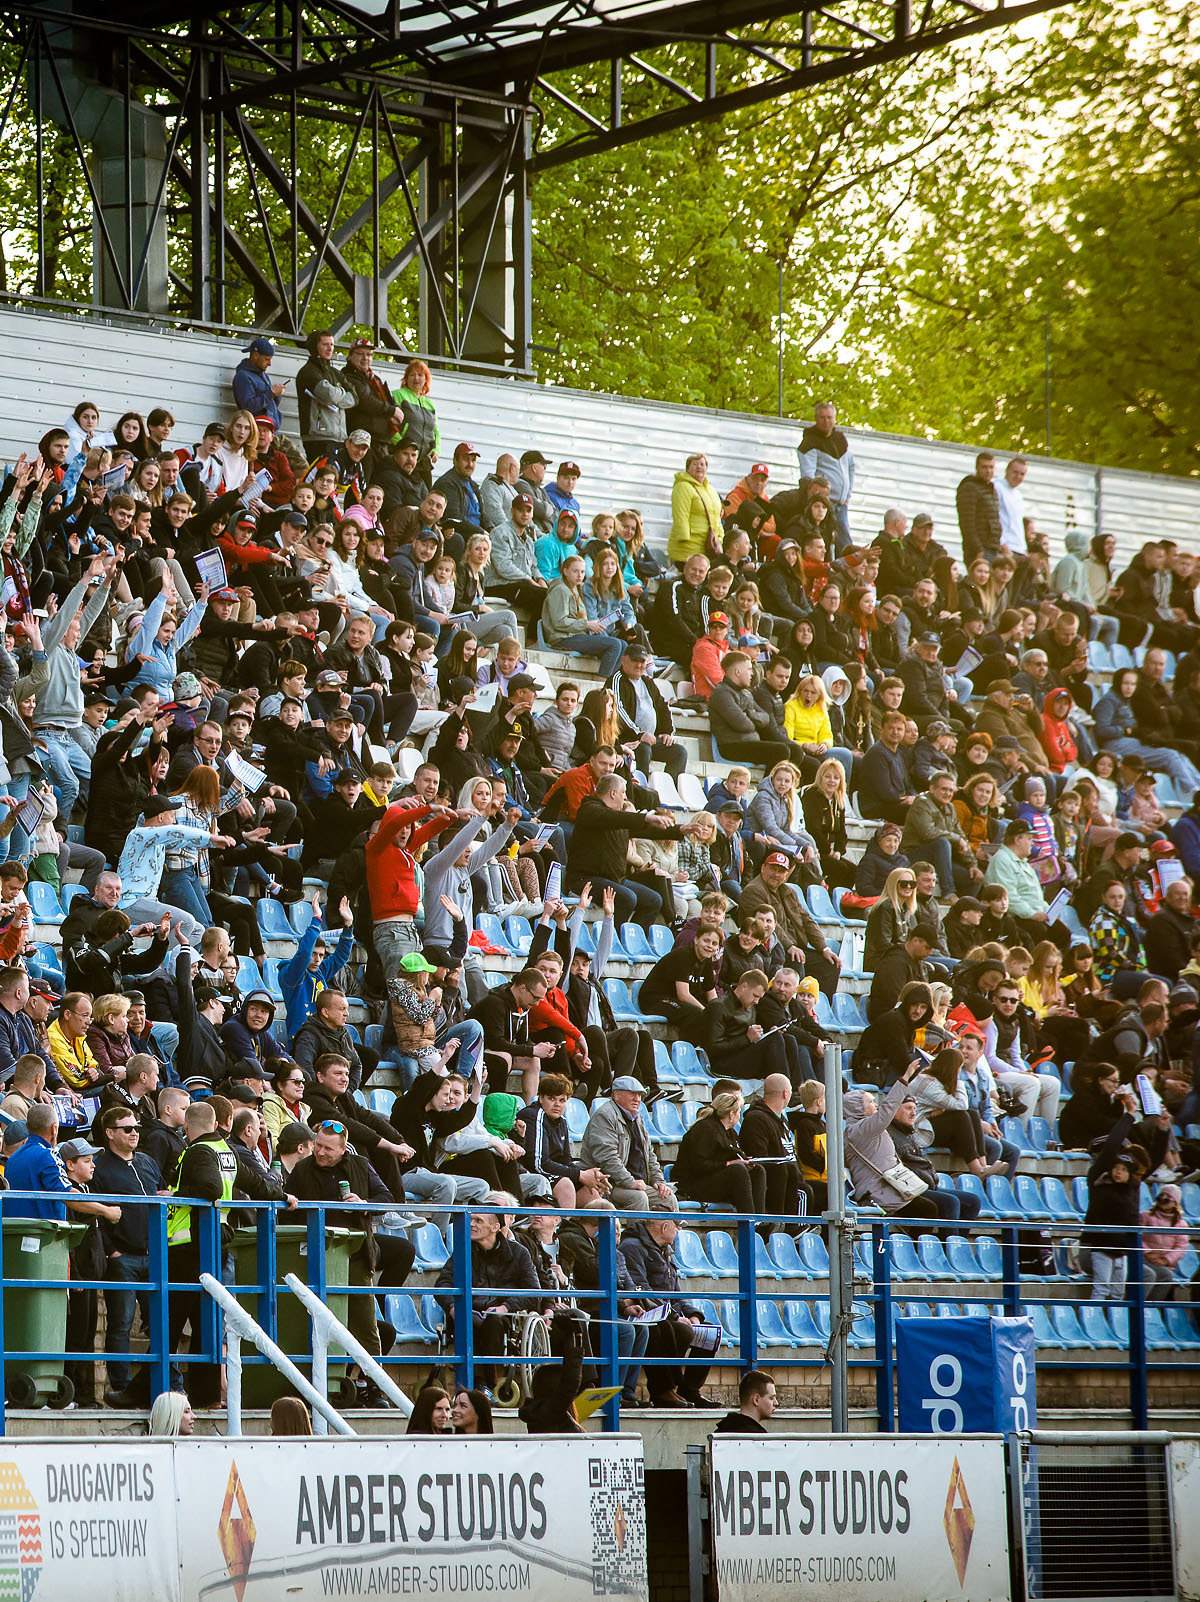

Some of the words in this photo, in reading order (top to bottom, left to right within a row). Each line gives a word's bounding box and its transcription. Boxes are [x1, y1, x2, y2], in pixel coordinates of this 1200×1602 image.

[45, 1462, 155, 1503] DAUGAVPILS
[714, 1470, 792, 1537] MBER
[798, 1469, 912, 1536] STUDIOS
[295, 1474, 409, 1545] AMBER
[416, 1472, 548, 1542] STUDIOS
[49, 1520, 65, 1560] IS
[69, 1518, 148, 1560] SPEEDWAY
[321, 1563, 531, 1597] WWW.AMBER-STUDIOS.COM
[717, 1557, 897, 1585] WWW.AMBER-STUDIOS.COM
